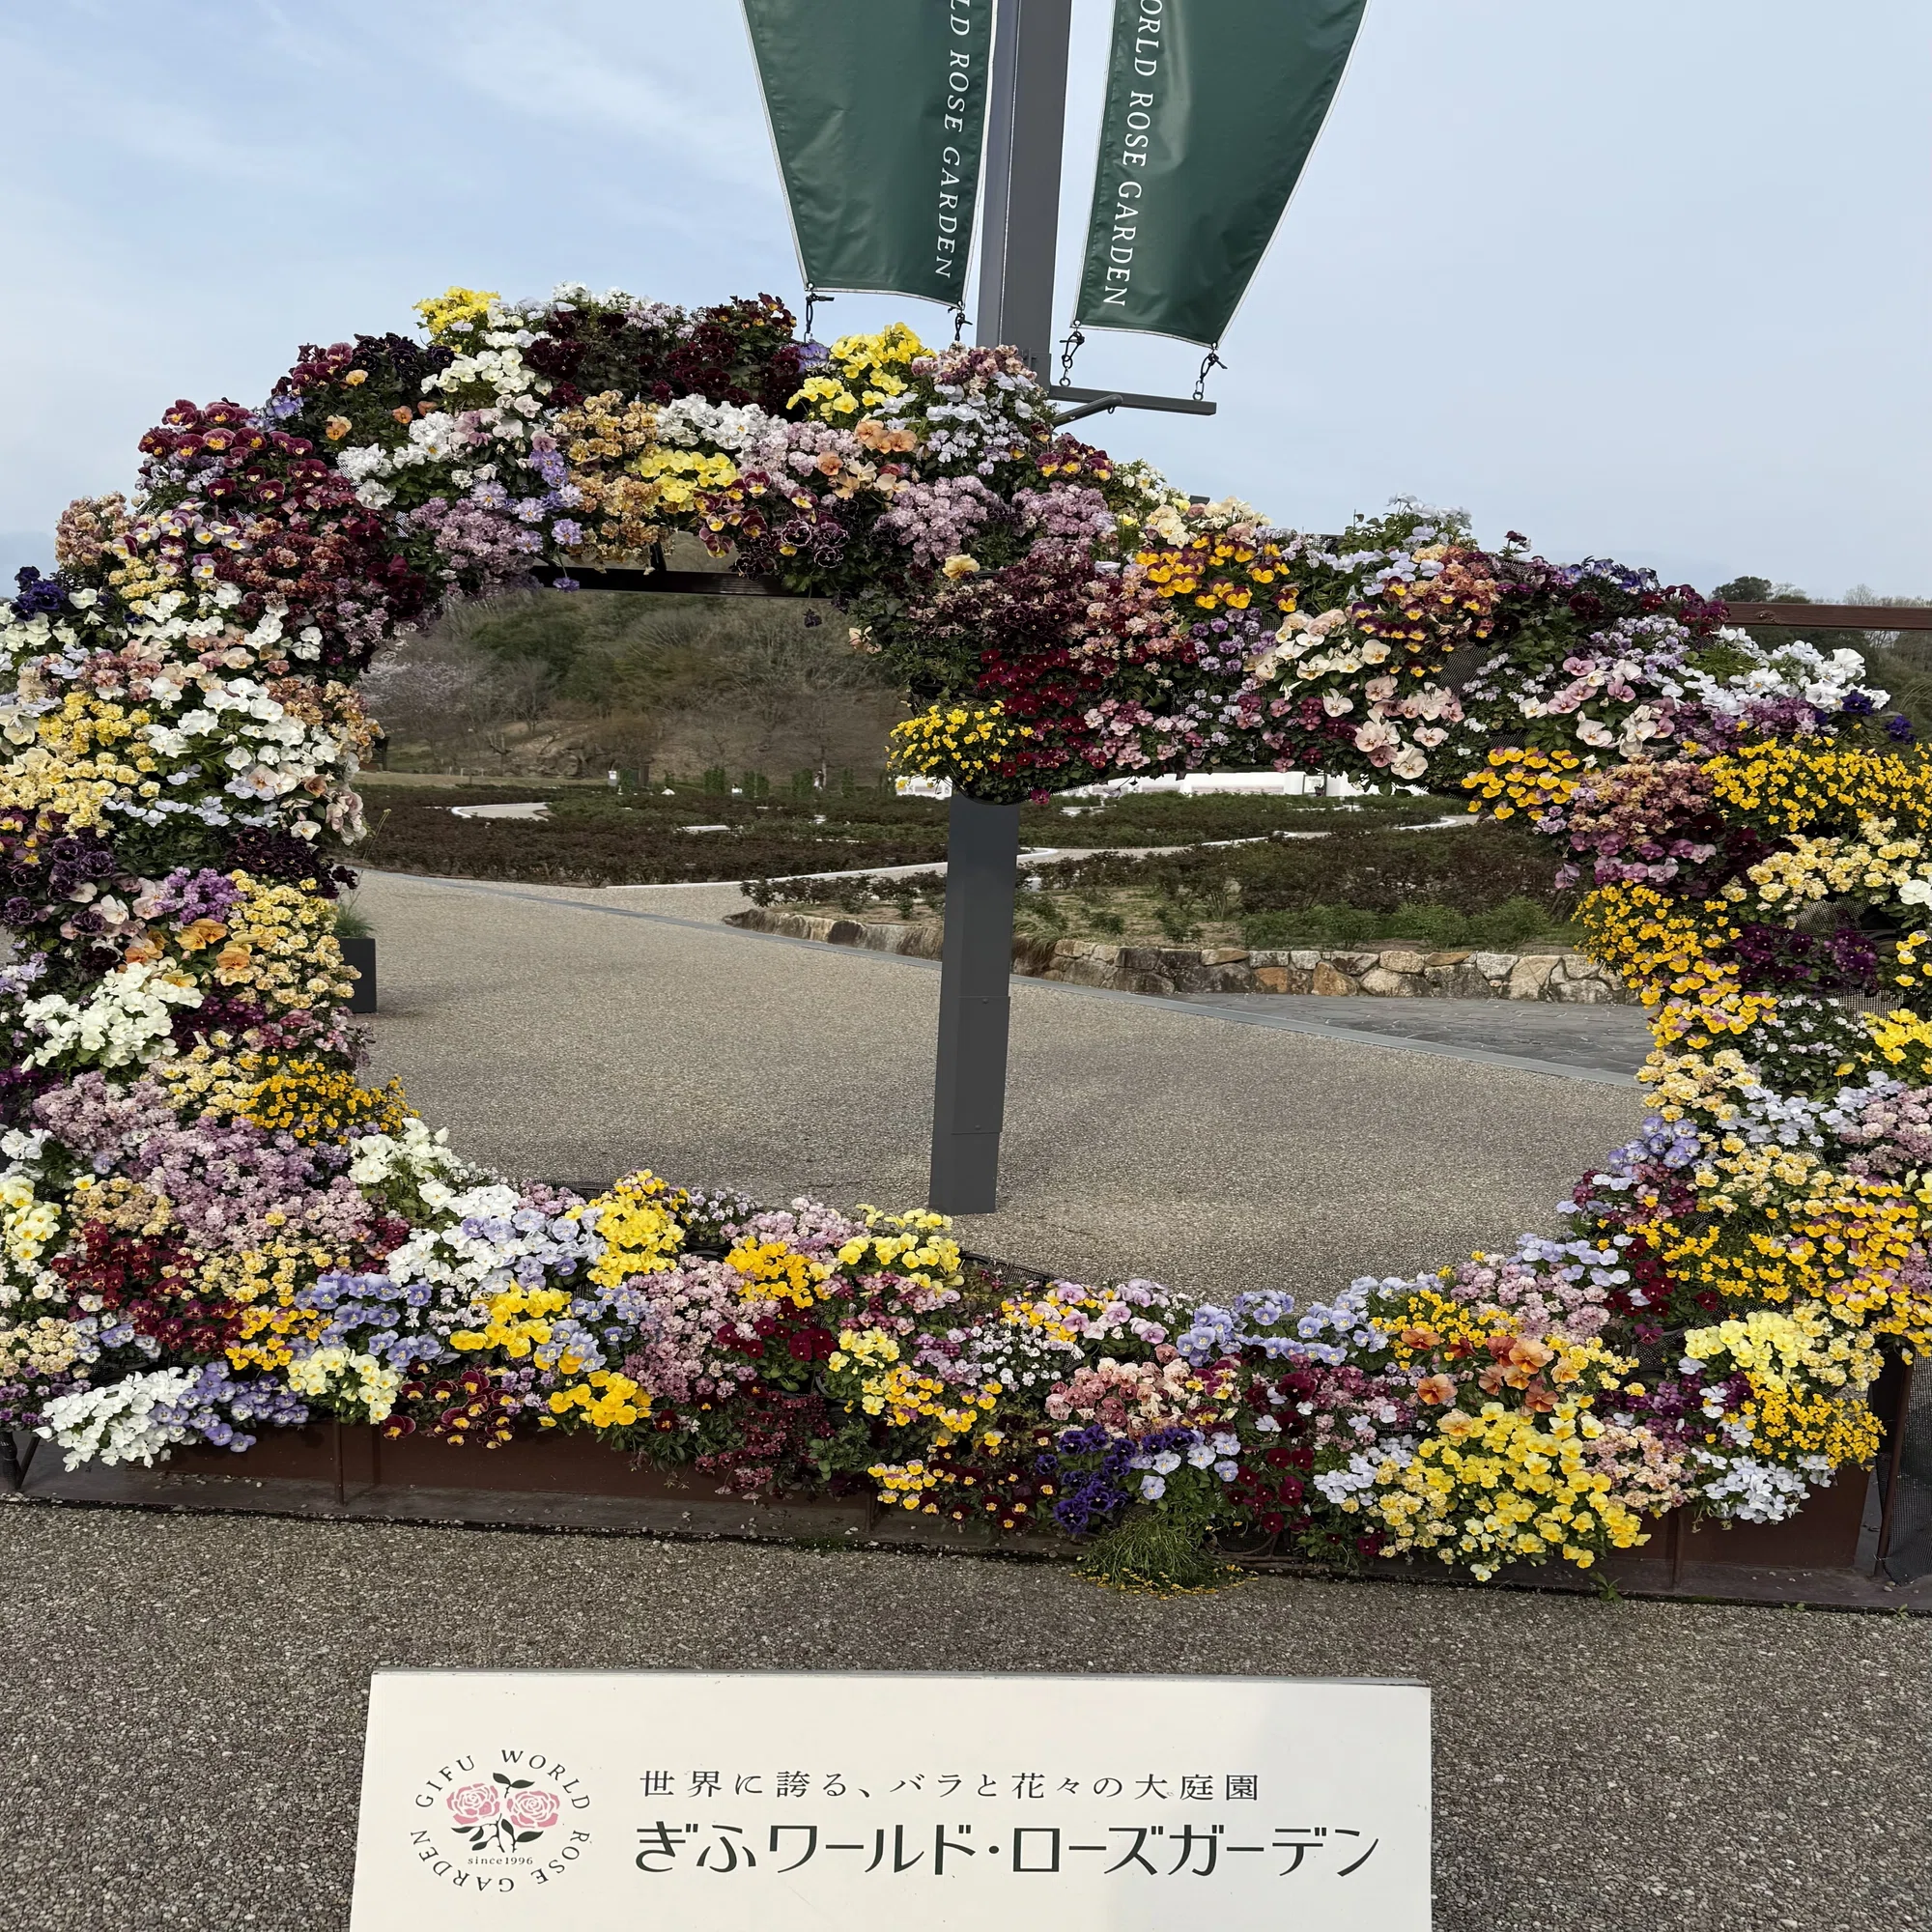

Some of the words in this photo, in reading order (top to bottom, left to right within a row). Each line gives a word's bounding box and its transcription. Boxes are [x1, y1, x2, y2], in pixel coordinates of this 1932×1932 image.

[944, 49, 970, 132] ROSE
[1122, 90, 1153, 167] ROSE
[935, 146, 960, 278] GARDEN
[1102, 181, 1143, 306] GARDEN
[414, 1754, 475, 1808] GIFU
[500, 1748, 591, 1809] WORLD
[639, 1769, 1259, 1802] 世界に誇る、バラと花々の大庭園
[410, 1830, 515, 1892] GARDEN
[530, 1830, 591, 1885] ROSE
[634, 1820, 1380, 1878] ぎふワールド・ローズガーデン
